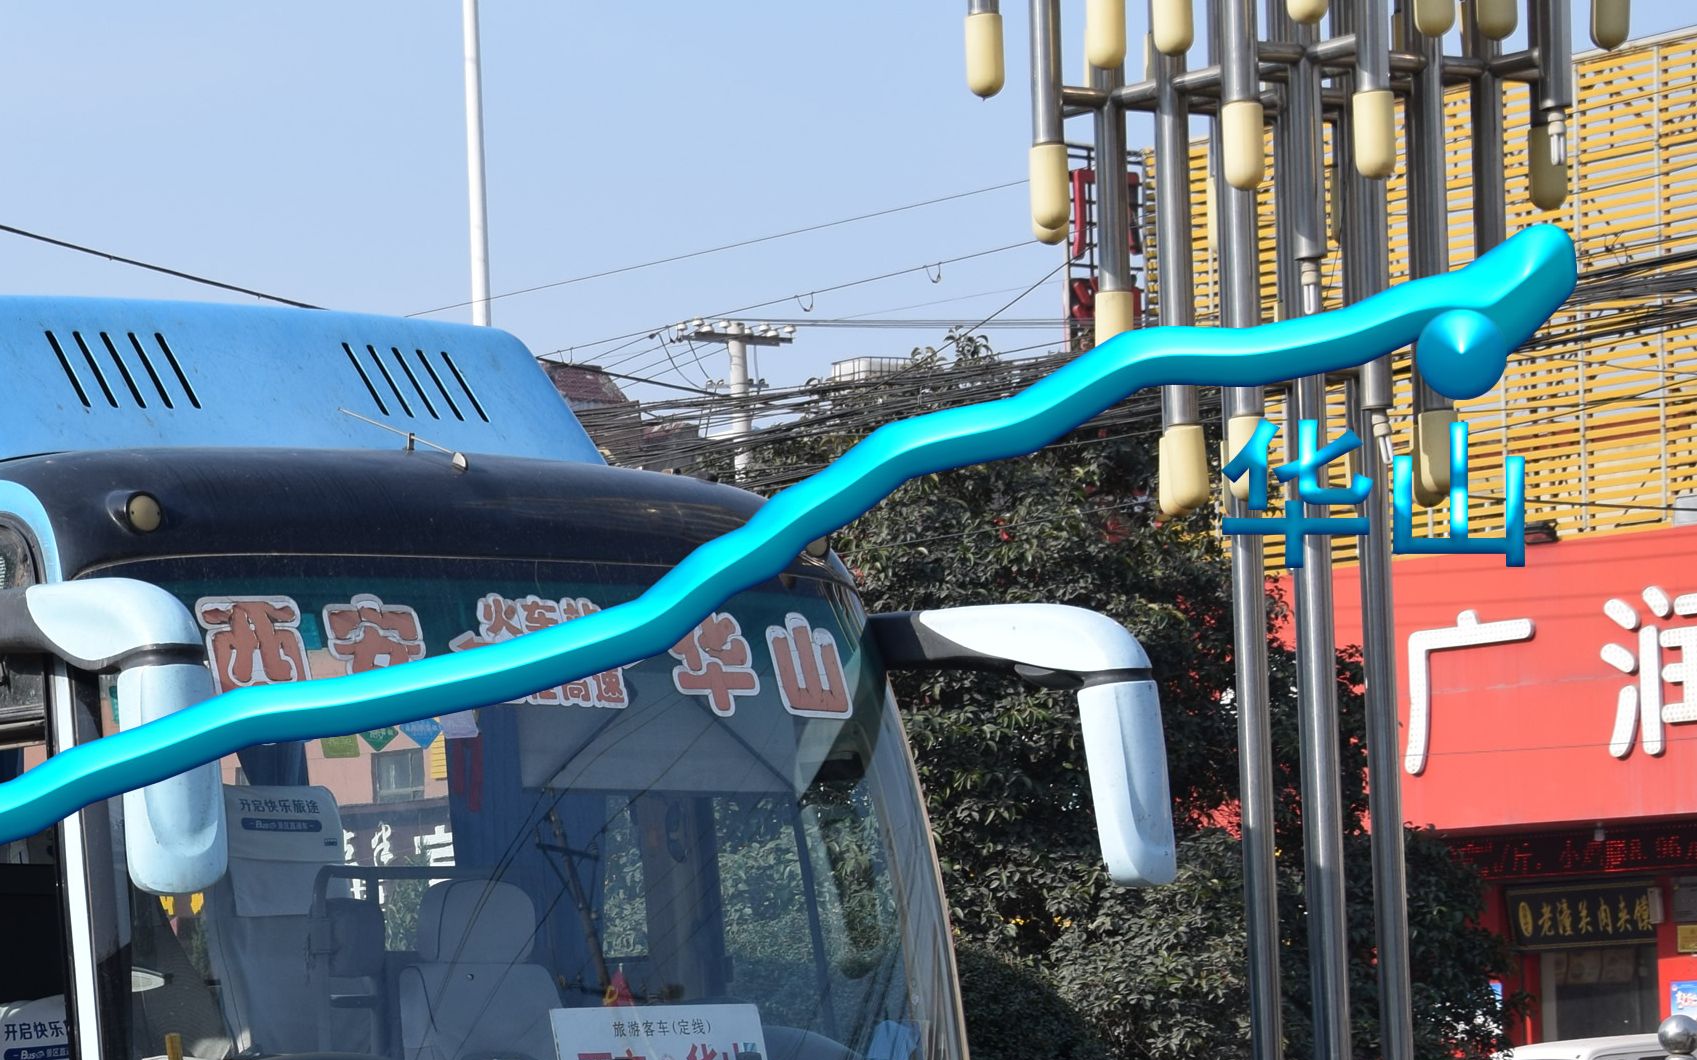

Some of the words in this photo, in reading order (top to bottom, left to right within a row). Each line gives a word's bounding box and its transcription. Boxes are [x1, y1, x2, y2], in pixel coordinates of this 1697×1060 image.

[669, 612, 854, 719] 华山
[612, 1018, 712, 1038] 旅游客车(定线)
